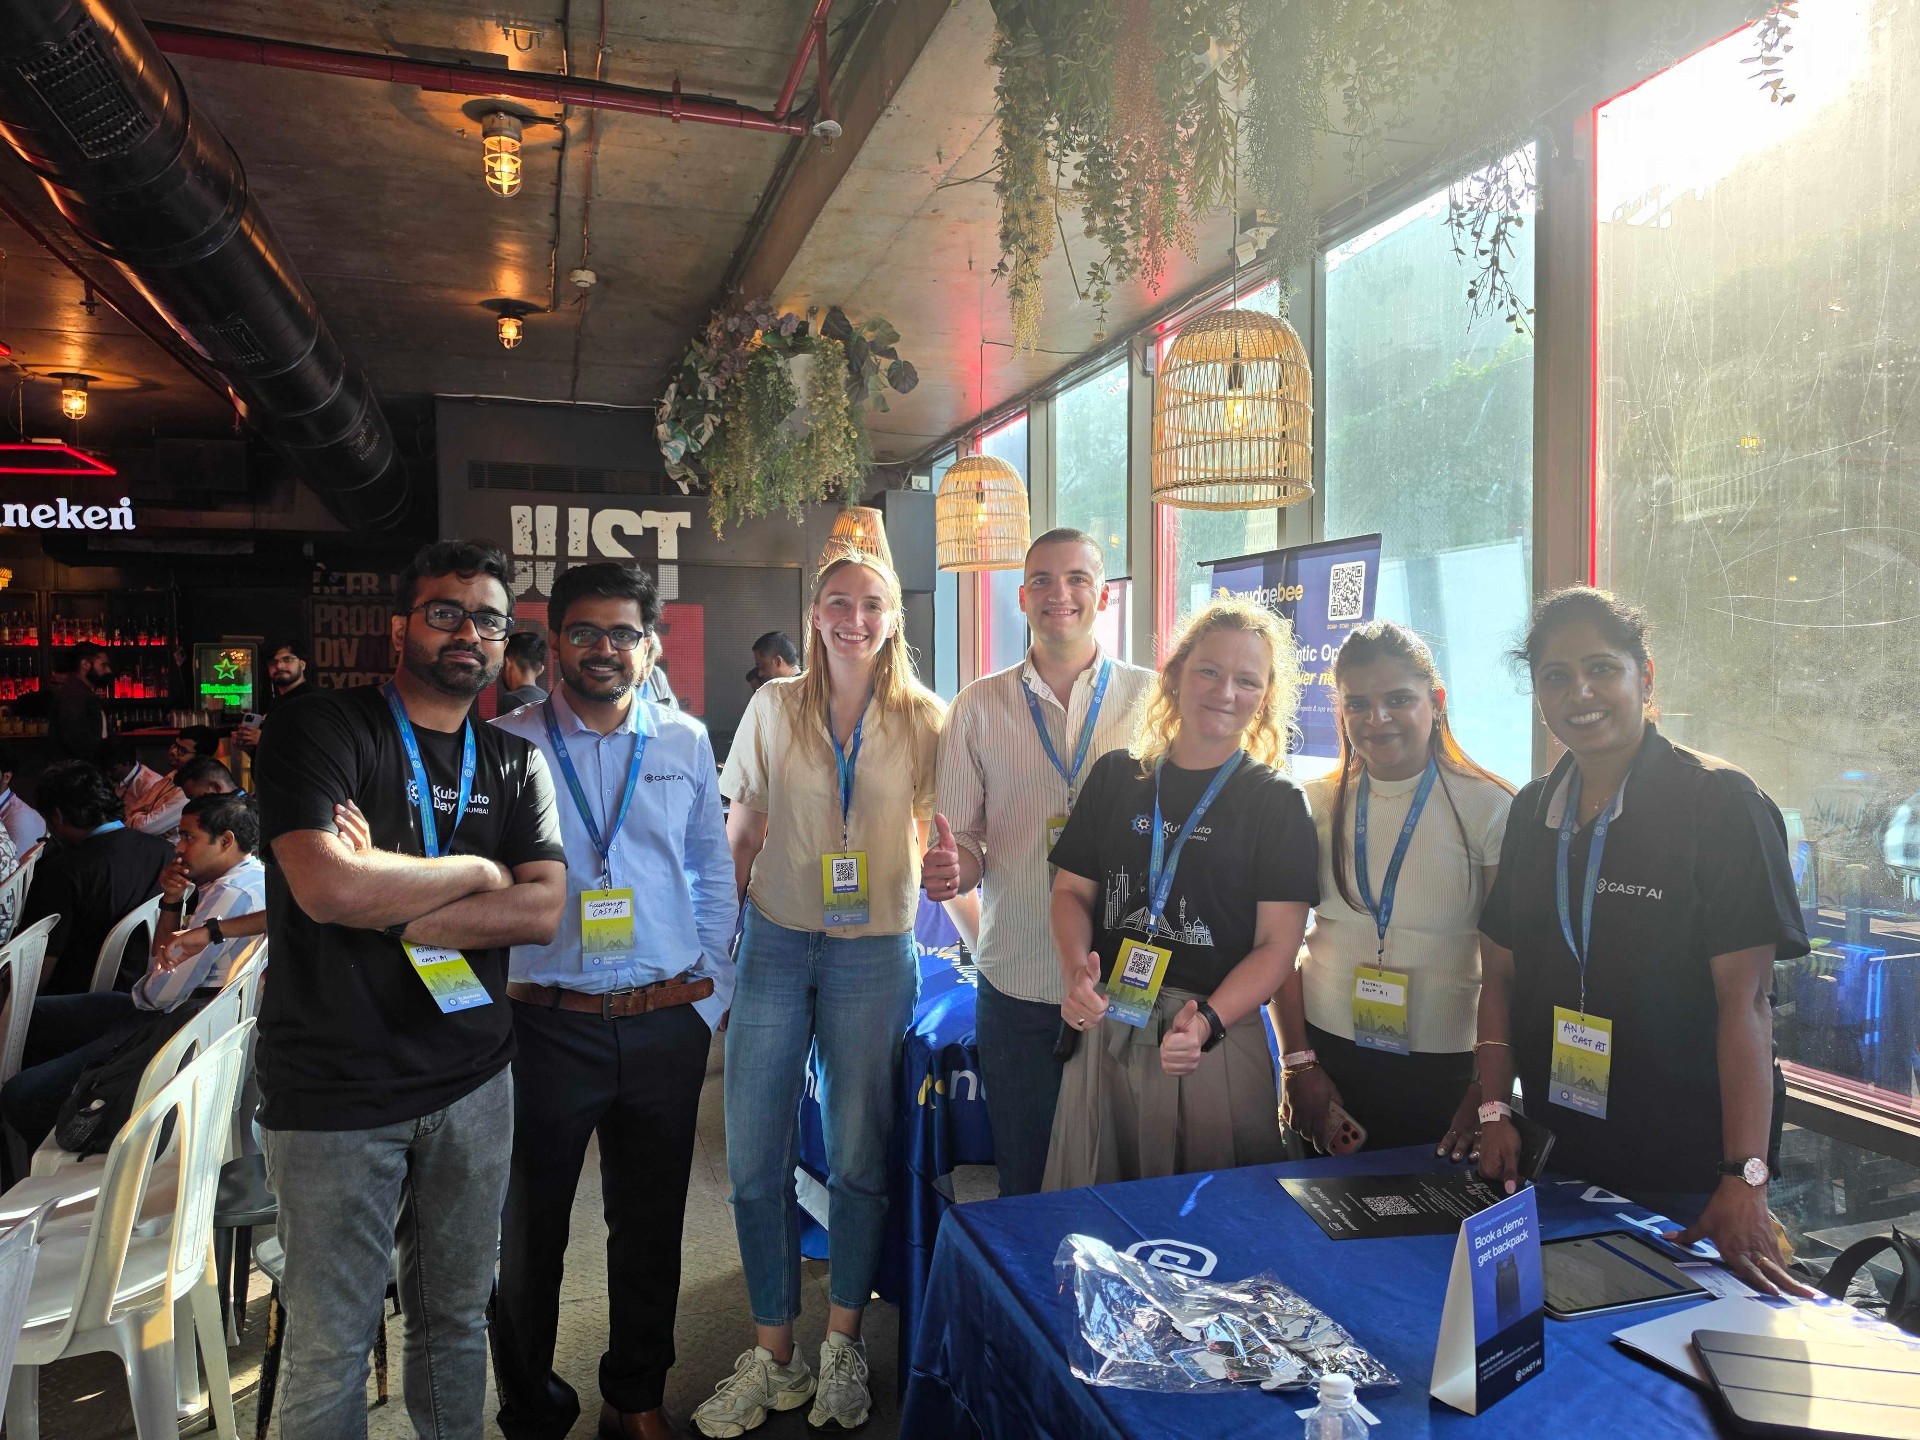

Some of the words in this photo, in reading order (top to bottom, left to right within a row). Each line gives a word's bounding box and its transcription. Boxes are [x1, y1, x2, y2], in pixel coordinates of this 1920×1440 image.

[0, 497, 136, 530] neken
[508, 505, 691, 600] JUST
[1321, 643, 1341, 665] Op
[655, 774, 677, 782] CAST
[432, 784, 490, 805] Kubuto
[433, 798, 456, 814] Day
[1162, 820, 1212, 835] Kuuto
[1608, 882, 1646, 896] CAST
[1646, 888, 1663, 900] AI
[1572, 1035, 1593, 1047] CAST
[1474, 1230, 1496, 1250] Book
[1496, 1228, 1502, 1238] a
[1502, 1217, 1524, 1235] demo
[1477, 1249, 1493, 1267] get
[1492, 1229, 1529, 1257] backpack
[1522, 1361, 1536, 1376] CAST
